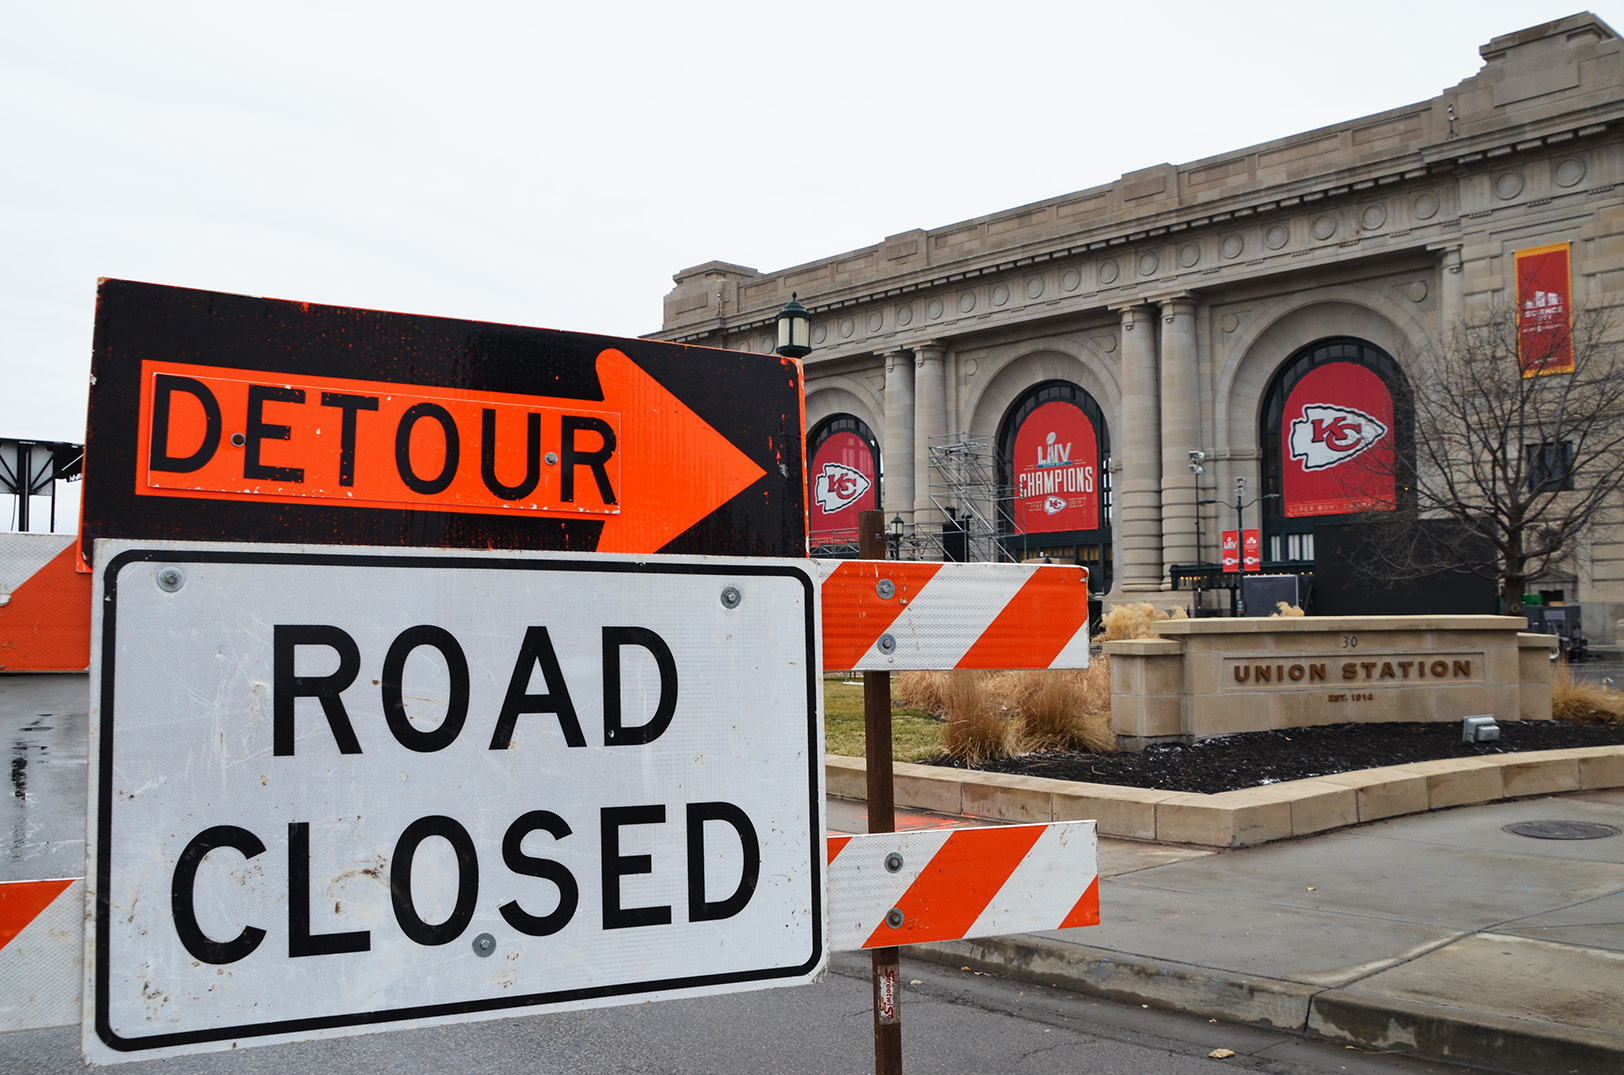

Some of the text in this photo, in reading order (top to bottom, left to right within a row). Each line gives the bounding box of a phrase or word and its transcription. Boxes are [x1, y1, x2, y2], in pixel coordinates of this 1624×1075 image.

[151, 375, 617, 506] DETOUR
[1311, 416, 1362, 452] KC
[827, 473, 857, 500] KC
[1019, 466, 1093, 498] CHAMPIONS
[1342, 636, 1358, 649] 30
[1234, 660, 1472, 683] UNION STATION
[273, 624, 678, 757] ROAD
[1327, 692, 1374, 703] EST. 1914
[171, 801, 762, 965] CLOSED
